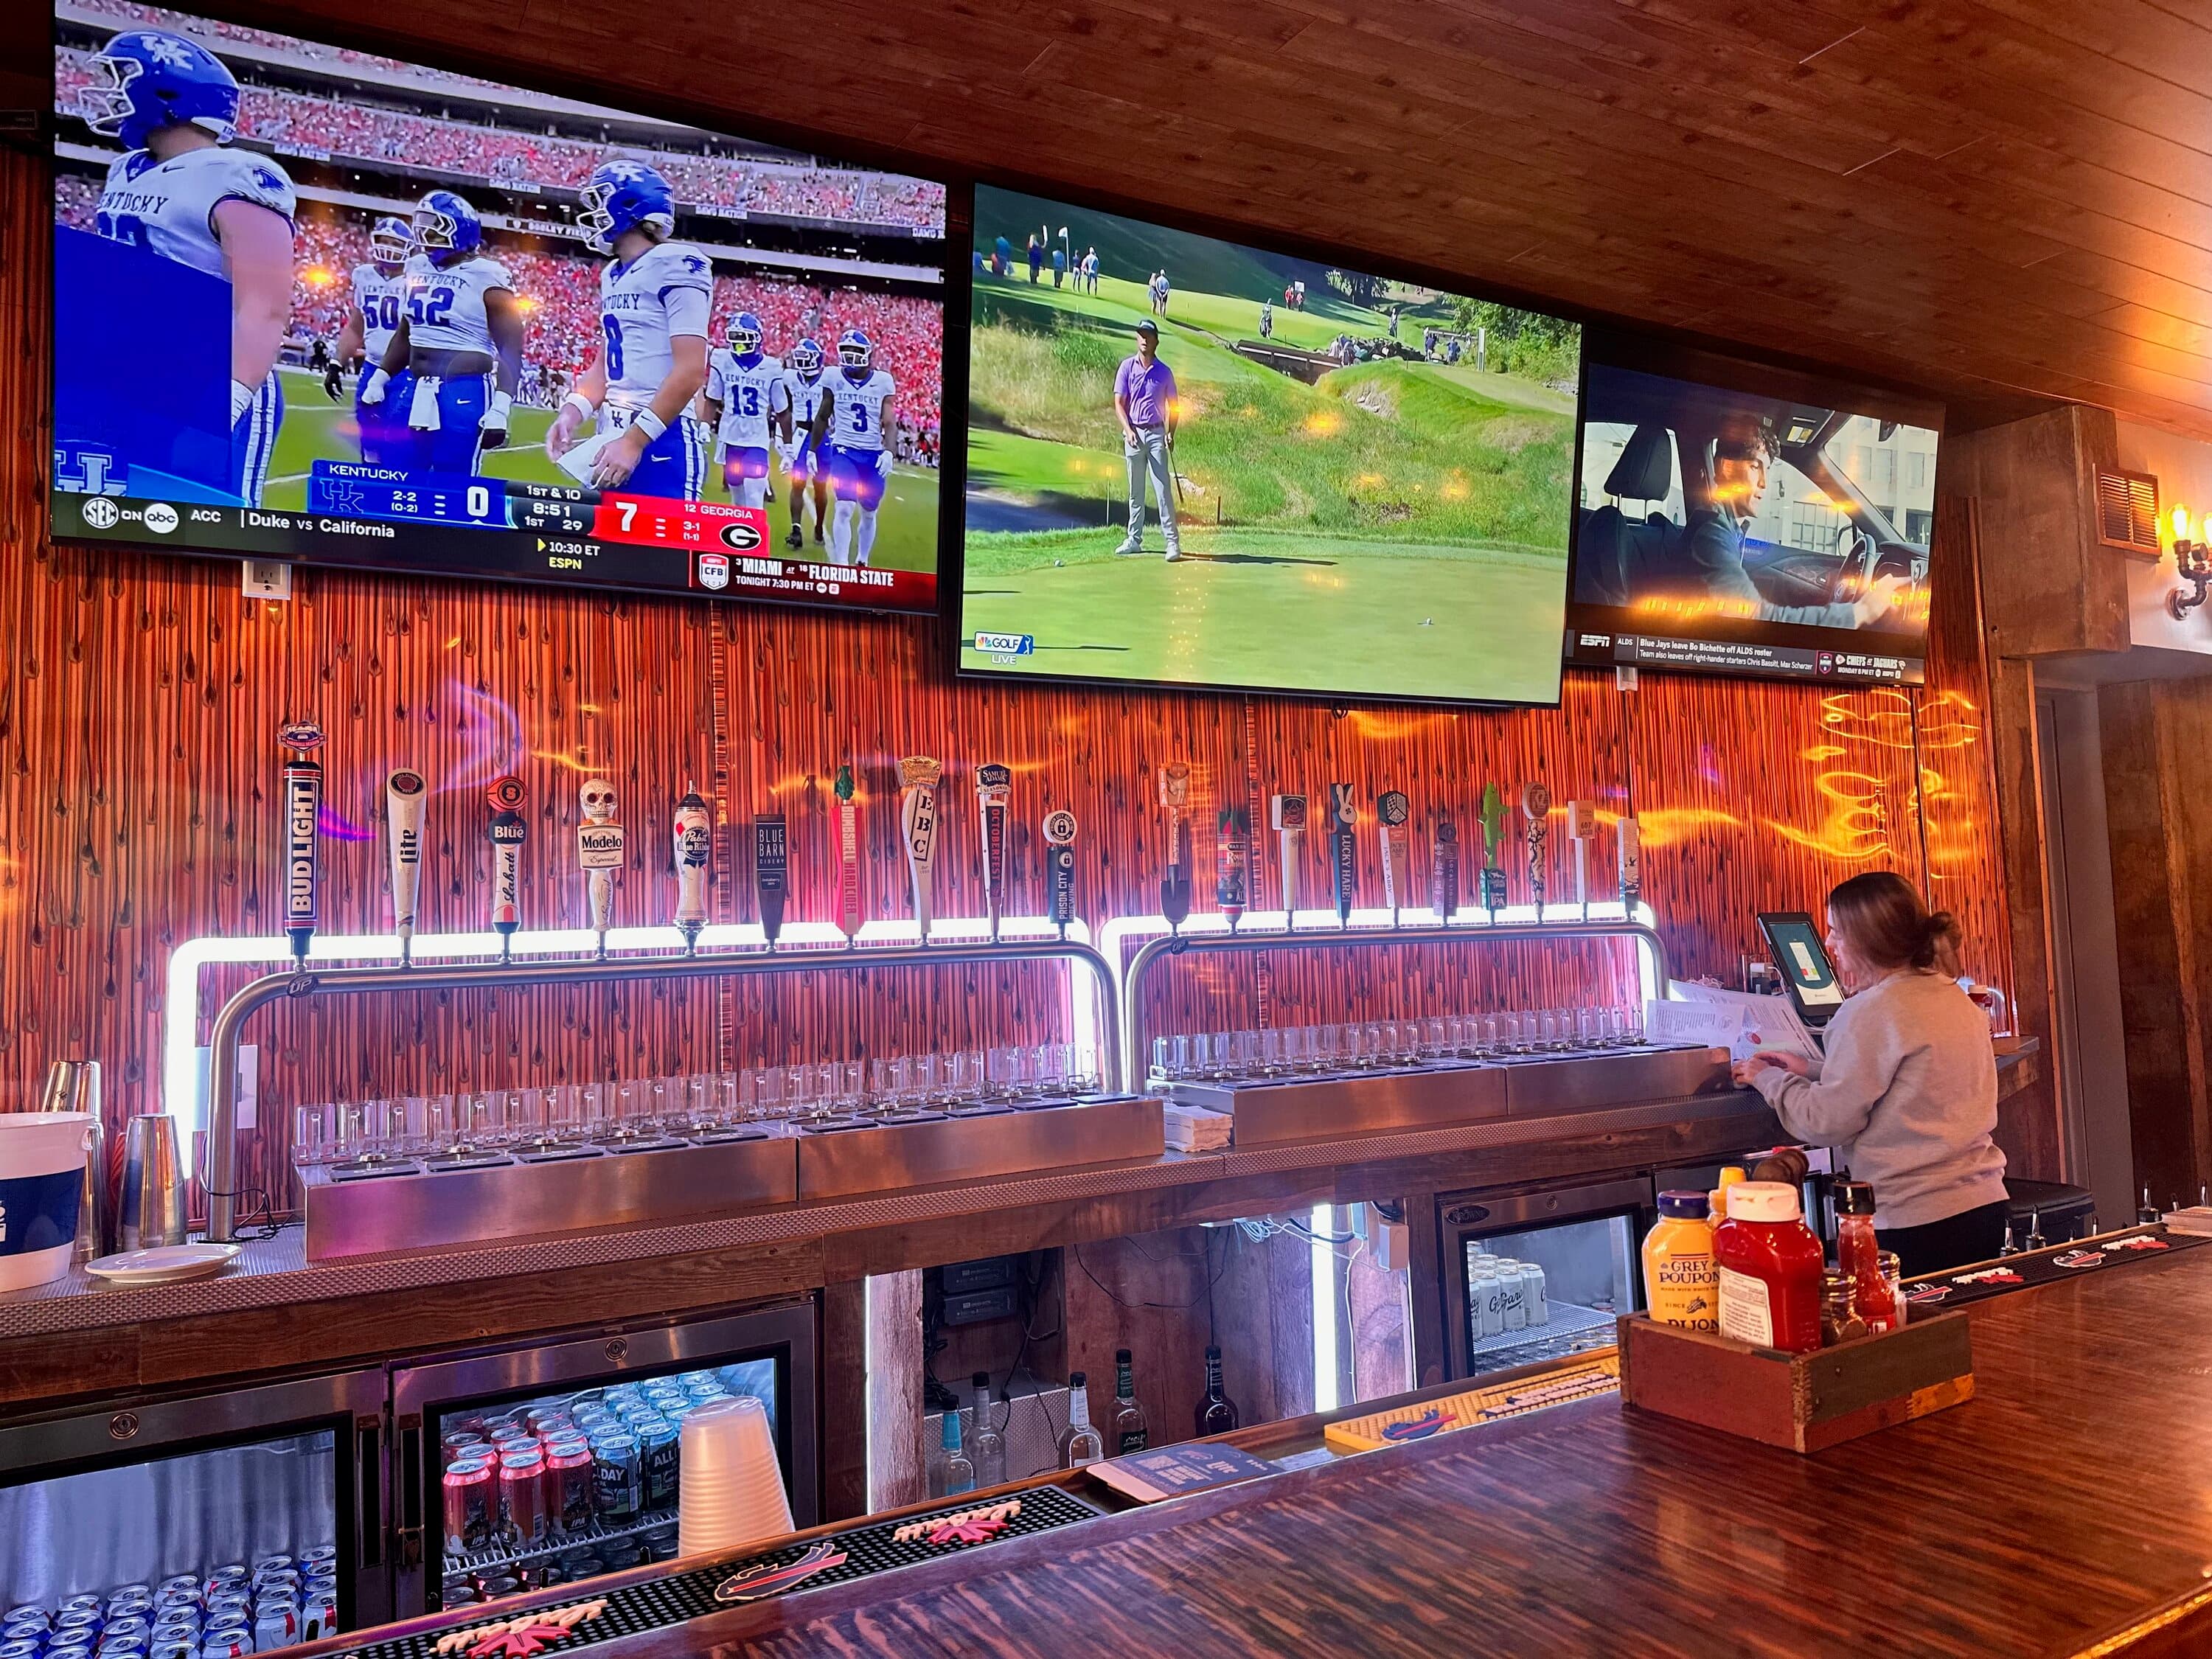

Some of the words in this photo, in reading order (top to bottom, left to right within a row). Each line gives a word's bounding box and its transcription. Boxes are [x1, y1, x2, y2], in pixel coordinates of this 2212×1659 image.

[363, 295, 399, 330] 50
[408, 285, 455, 327] 52
[603, 313, 623, 380] 8
[726, 373, 765, 388] KENTUCKY
[731, 384, 759, 416] 13
[838, 392, 878, 405] KENTUCKY
[851, 403, 868, 432] 3
[330, 465, 408, 481] KENTUCKY
[392, 491, 417, 501] 2-2
[526, 485, 548, 496] 1ST
[551, 487, 562, 498] &
[565, 490, 581, 501] 10
[391, 502, 417, 513] (0-2)
[467, 486, 489, 517] 0
[533, 502, 571, 517] 8:51
[86, 500, 116, 526] SEC
[121, 510, 142, 521] ON
[147, 512, 176, 523] abc
[190, 509, 221, 523] ACC
[616, 501, 638, 532] 7
[684, 504, 697, 513] 12
[700, 505, 754, 520] GEORGIA
[248, 512, 291, 529] Duke
[296, 518, 313, 530] vs
[319, 518, 395, 538] California
[524, 515, 545, 527] 1ST
[563, 520, 582, 530] 29
[683, 521, 700, 531] 3-1
[683, 532, 700, 541] (1-1)
[549, 542, 582, 554] 10:30
[585, 546, 601, 556] ET
[549, 557, 582, 570] ESPN
[705, 567, 723, 575] CFB
[736, 558, 742, 566] 3
[742, 558, 782, 576] MIAMI
[799, 564, 808, 572] 18
[809, 565, 858, 583] FLORIDA
[860, 569, 894, 586] STATE
[736, 575, 771, 588] TONIGHT
[772, 578, 790, 589] 7:30
[790, 581, 804, 591] PM
[804, 582, 814, 591] ET
[992, 638, 1019, 649] GOLF
[1580, 634, 1610, 647] ESPN
[1617, 638, 1632, 646] ALDS
[1640, 639, 1655, 647] Blue
[1655, 639, 1670, 650] Jays
[1672, 641, 1688, 650] leave
[1689, 642, 1698, 650] Bo
[1699, 643, 1725, 653] Bichette
[1726, 646, 1735, 654] off
[1736, 646, 1753, 655] ALDS
[1754, 648, 1773, 657] roster
[991, 654, 1017, 664] LIVE
[1640, 650, 1655, 658] Team
[1655, 650, 1667, 658] also
[1667, 652, 1684, 660] leaves
[1685, 653, 1693, 661] off
[1726, 656, 1747, 665] starters
[1747, 658, 1760, 667] Chris
[1780, 661, 1791, 669] Max
[292, 787, 315, 855] LIGHT
[495, 825, 524, 838] Blue
[686, 831, 707, 842] Pabst
[759, 829, 784, 843] BLUE
[843, 806, 855, 861] BOMBSHELL
[400, 830, 420, 863] Lite
[582, 835, 622, 849] Modelo
[759, 843, 785, 857] BARN
[991, 808, 1000, 881] OCTOBERFEST
[1341, 835, 1351, 870] LUCKY
[502, 851, 515, 904] Labatt
[844, 863, 856, 886] HARD
[1058, 872, 1068, 891] CITY
[292, 864, 312, 913] BUD
[1341, 871, 1351, 899] HARE
[844, 887, 857, 914] CIDER
[1058, 891, 1068, 920] PRISON
[1490, 896, 1505, 906] IPA
[1671, 1260, 1709, 1273] GREY
[1660, 1272, 1720, 1284] POUPON
[654, 1450, 674, 1467] ALL
[601, 1468, 625, 1481] DAY
[571, 1517, 585, 1528] IPA
[472, 1534, 485, 1545] IPA
